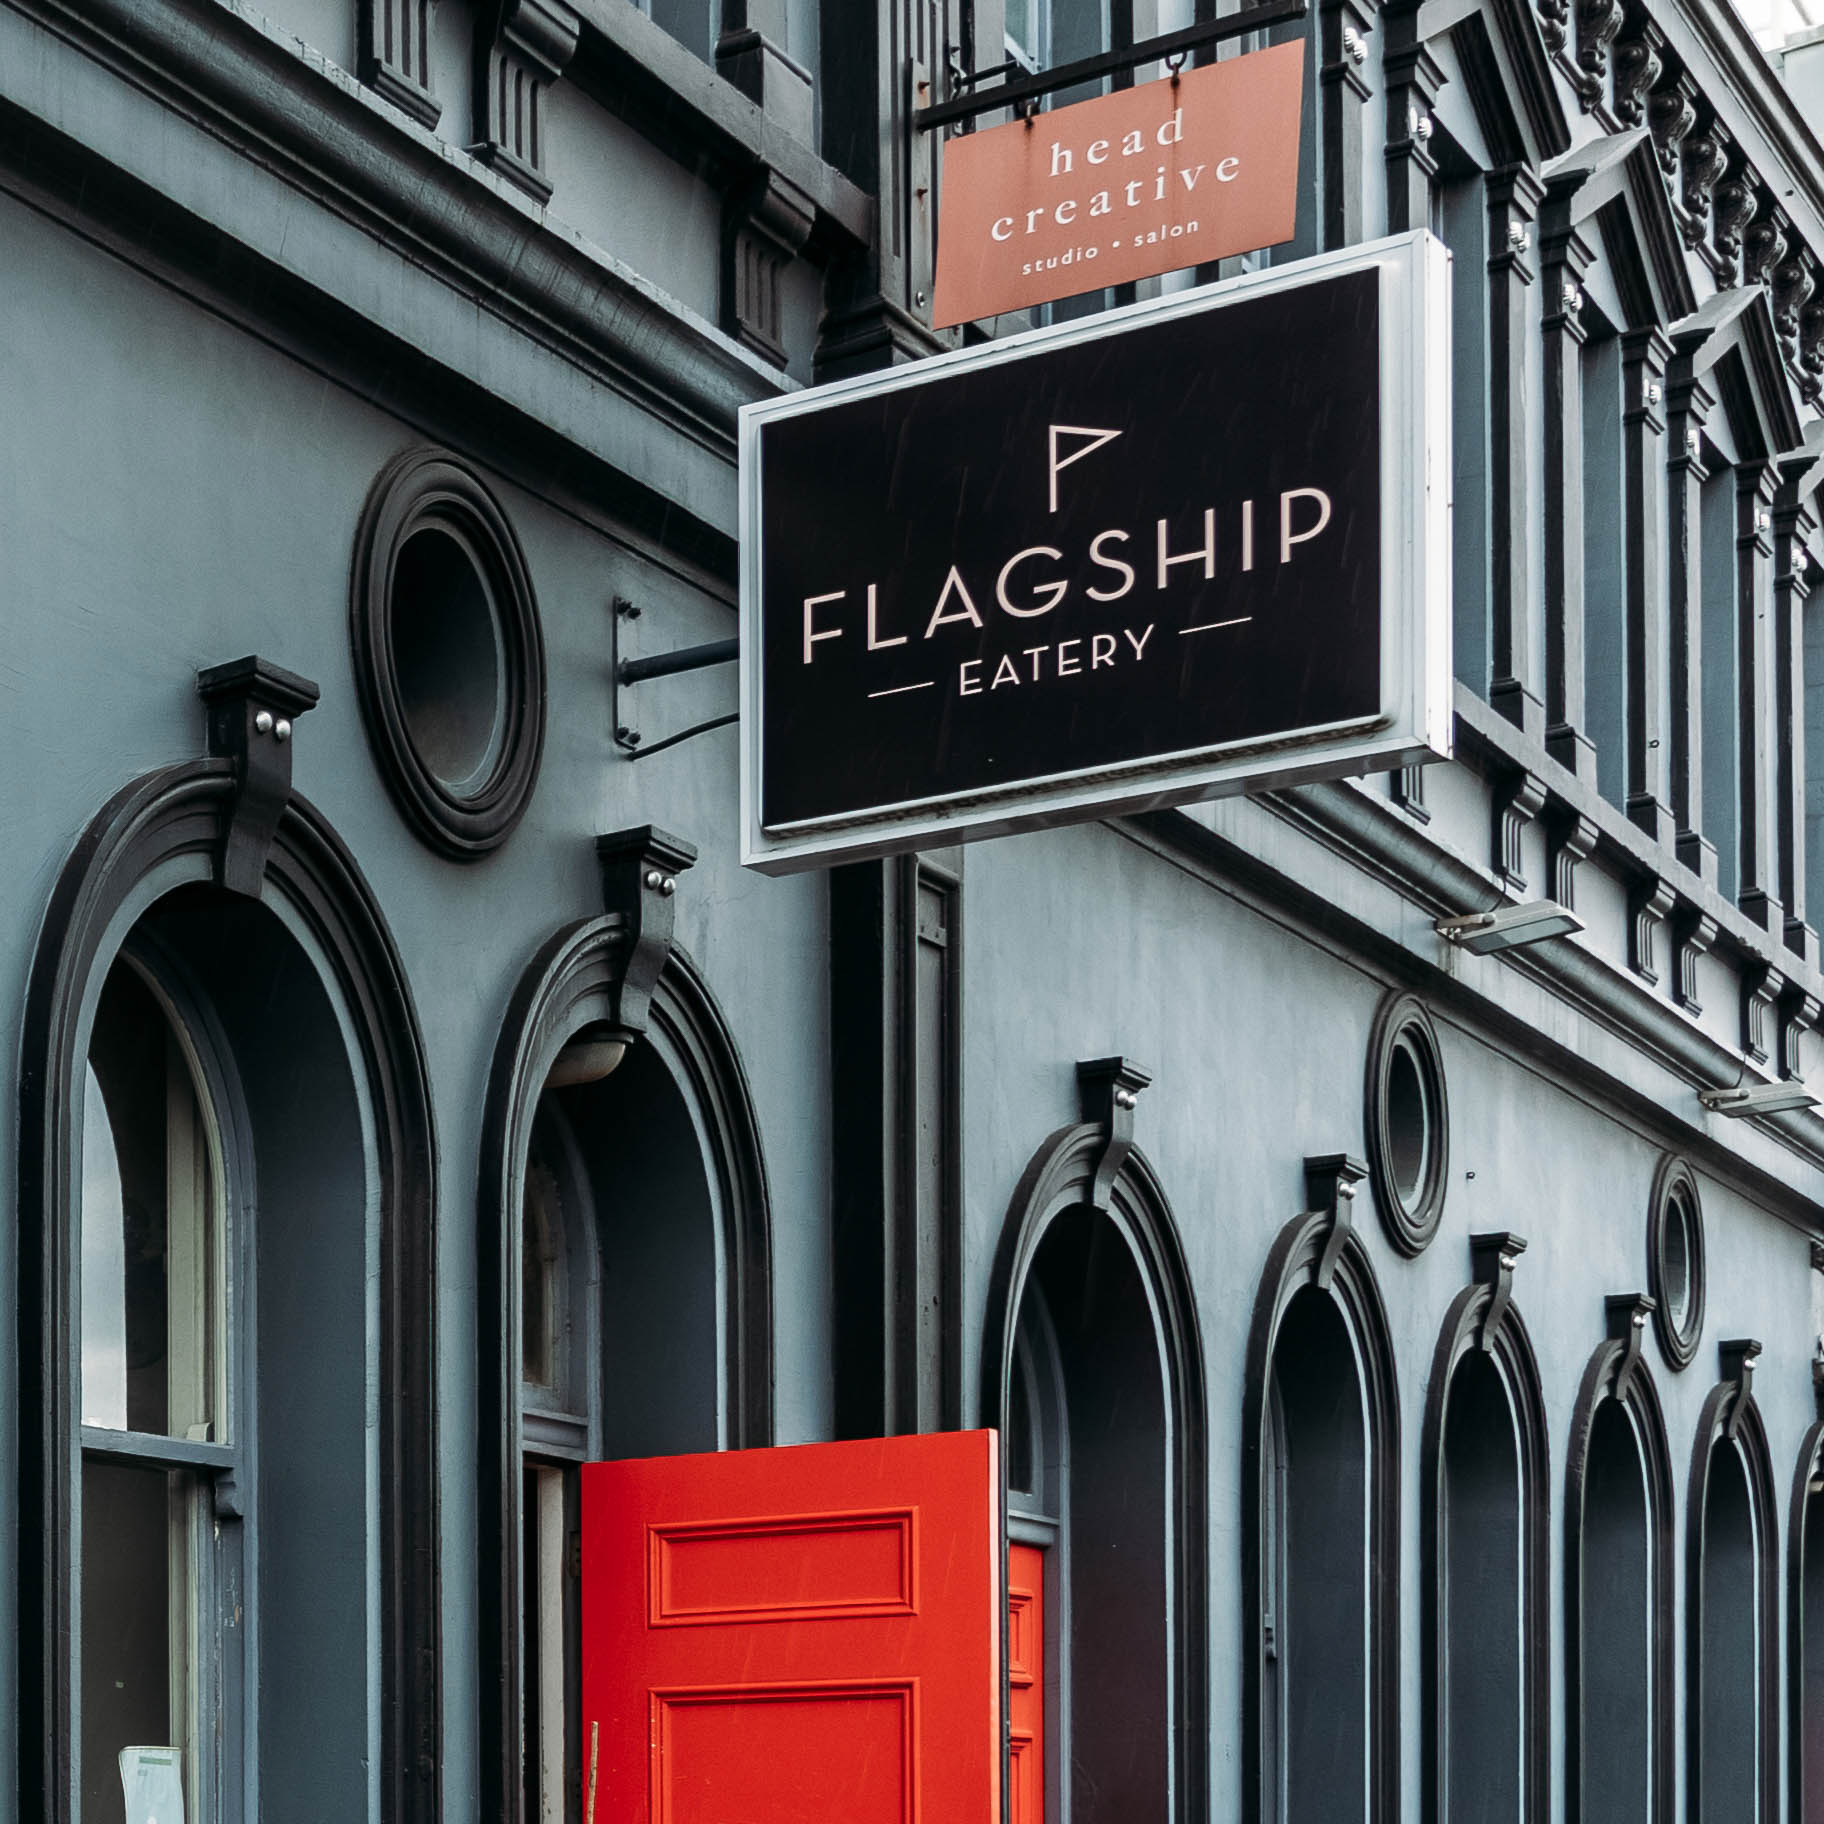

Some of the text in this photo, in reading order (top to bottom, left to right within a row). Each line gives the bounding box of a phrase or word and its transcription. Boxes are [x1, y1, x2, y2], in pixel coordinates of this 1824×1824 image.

[1049, 108, 1184, 177] head
[990, 155, 1240, 242] creative
[1022, 219, 1200, 275] studio salon
[803, 487, 1331, 664] FLAGSHIP
[959, 623, 1155, 696] EATERY
